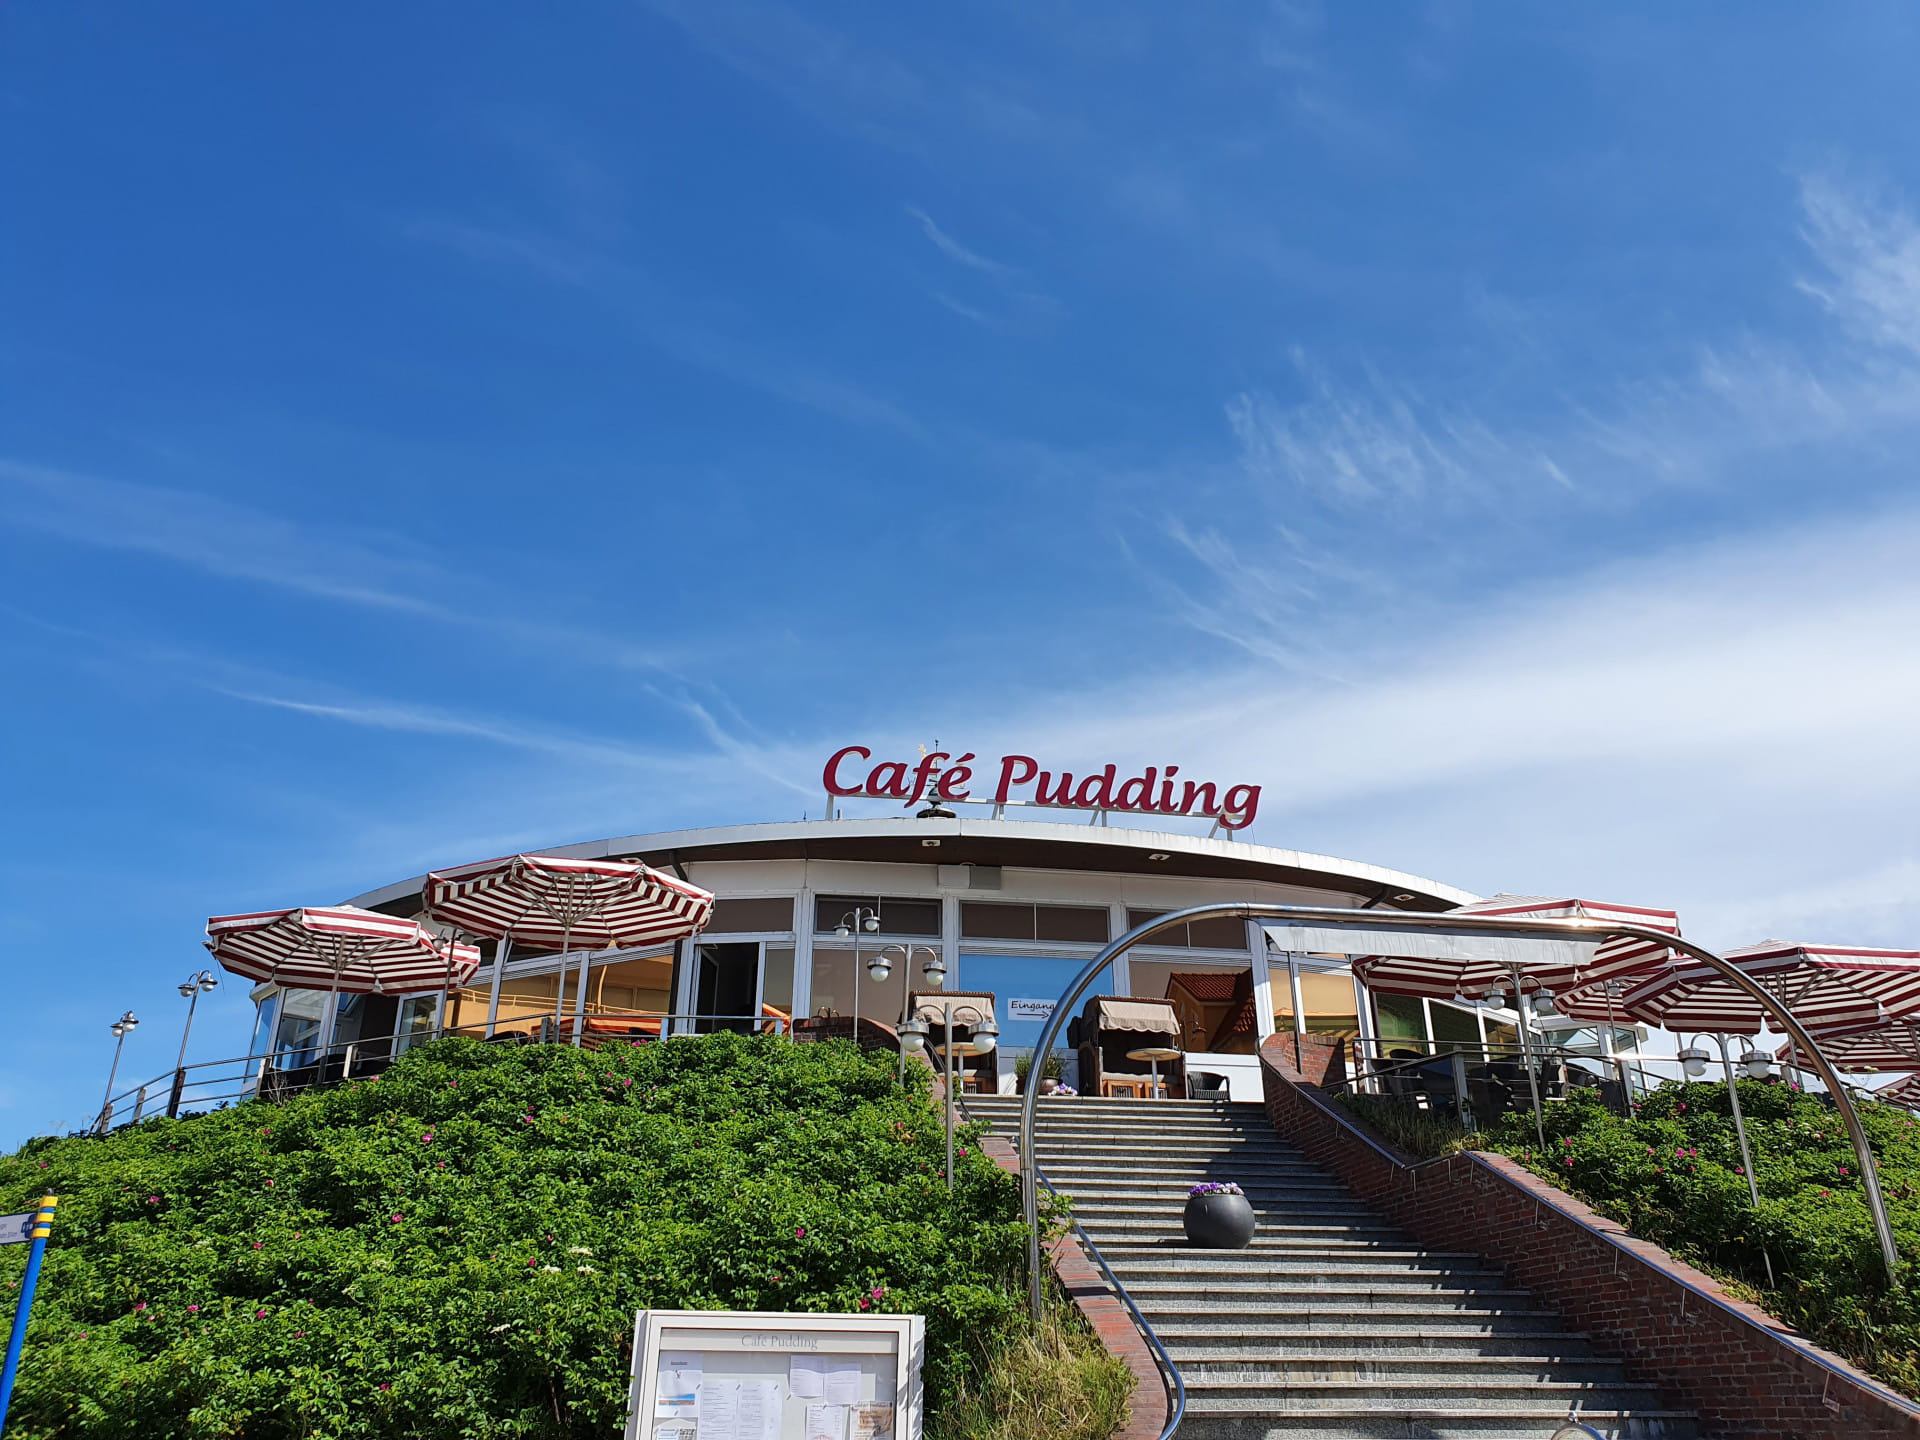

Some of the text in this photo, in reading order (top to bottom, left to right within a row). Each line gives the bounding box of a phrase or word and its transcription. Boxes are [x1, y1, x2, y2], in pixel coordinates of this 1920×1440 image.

[823, 745, 1262, 830] Café Pudding
[1011, 1000, 1056, 1012] Eingang
[771, 1334, 818, 1351] Pudding
